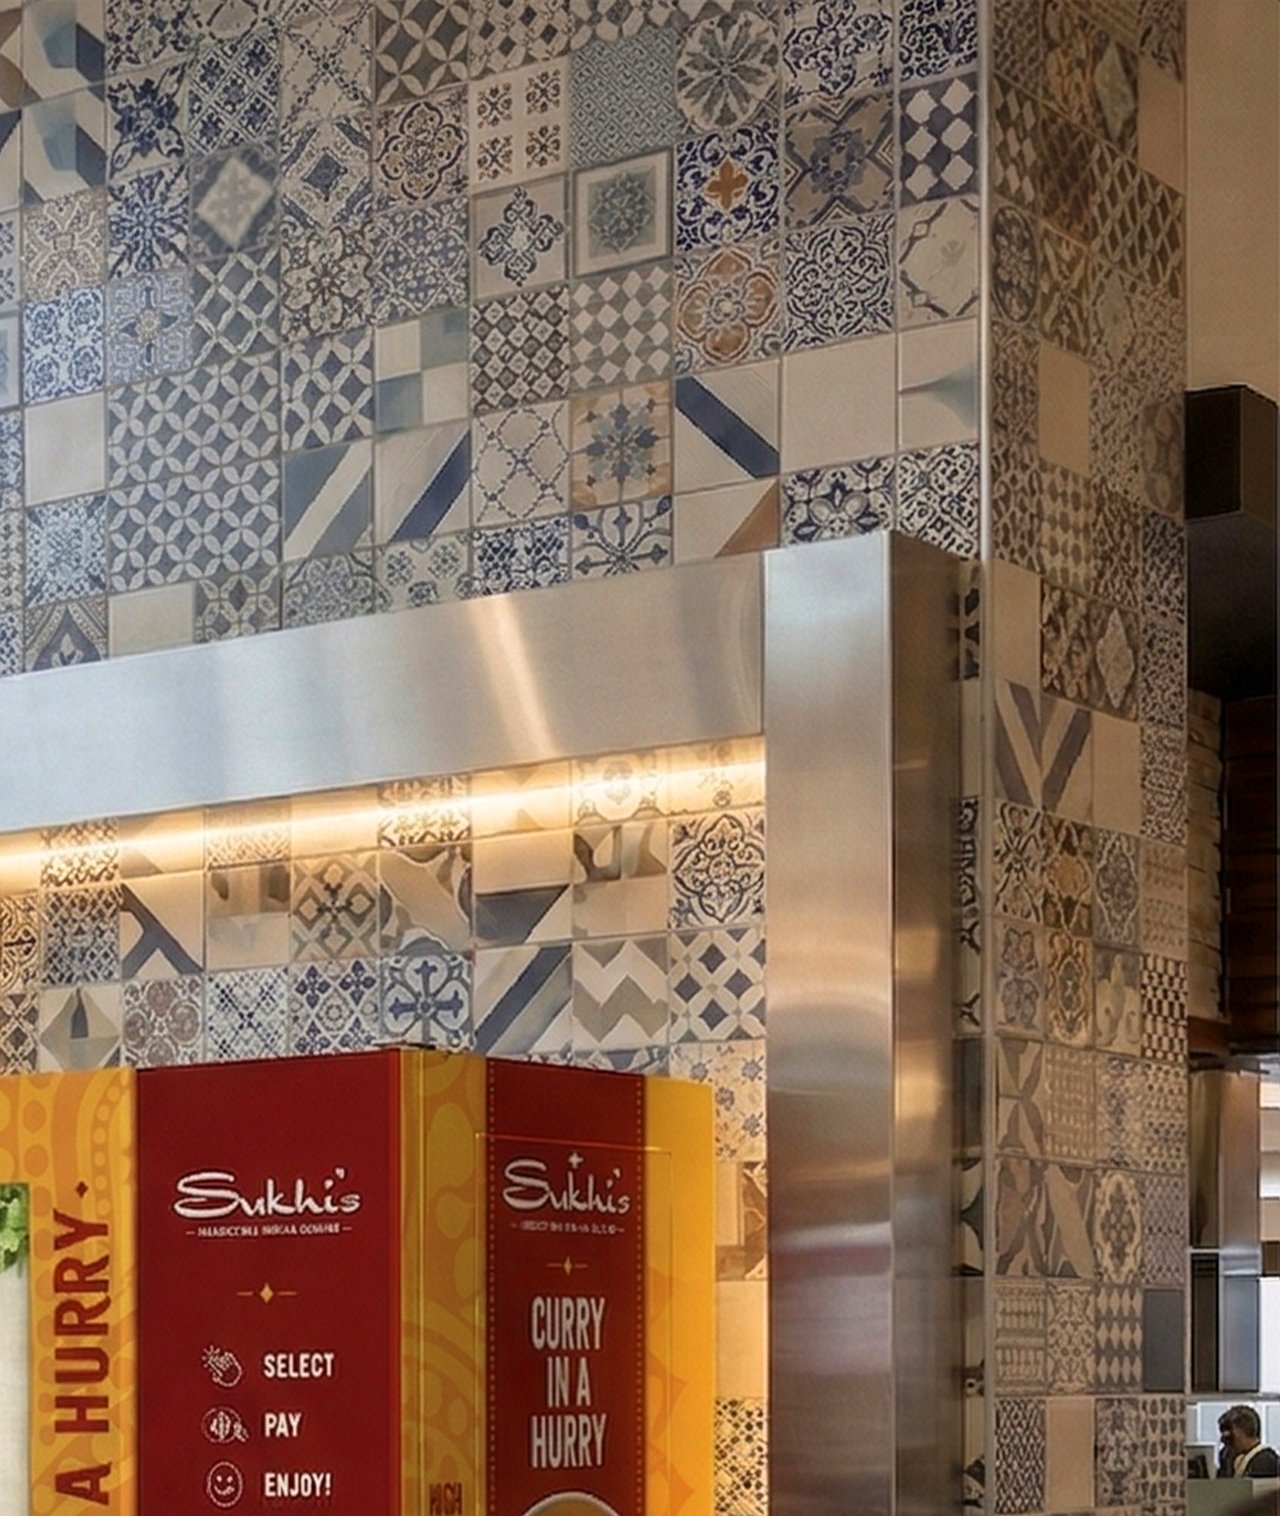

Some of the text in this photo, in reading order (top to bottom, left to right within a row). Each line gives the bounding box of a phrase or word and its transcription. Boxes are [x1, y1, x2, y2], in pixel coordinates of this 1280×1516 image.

[175, 1167, 362, 1218] Sukhi's
[502, 1158, 631, 1214] Sukhi's
[53, 1208, 112, 1434] HURRY
[531, 1295, 606, 1350] CURRY
[263, 1352, 335, 1379] SELECT
[547, 1355, 592, 1408] IN A
[264, 1412, 302, 1438] PAY
[531, 1412, 607, 1469] HURRY
[54, 1461, 112, 1506] A
[264, 1472, 332, 1498] ENJOY!
